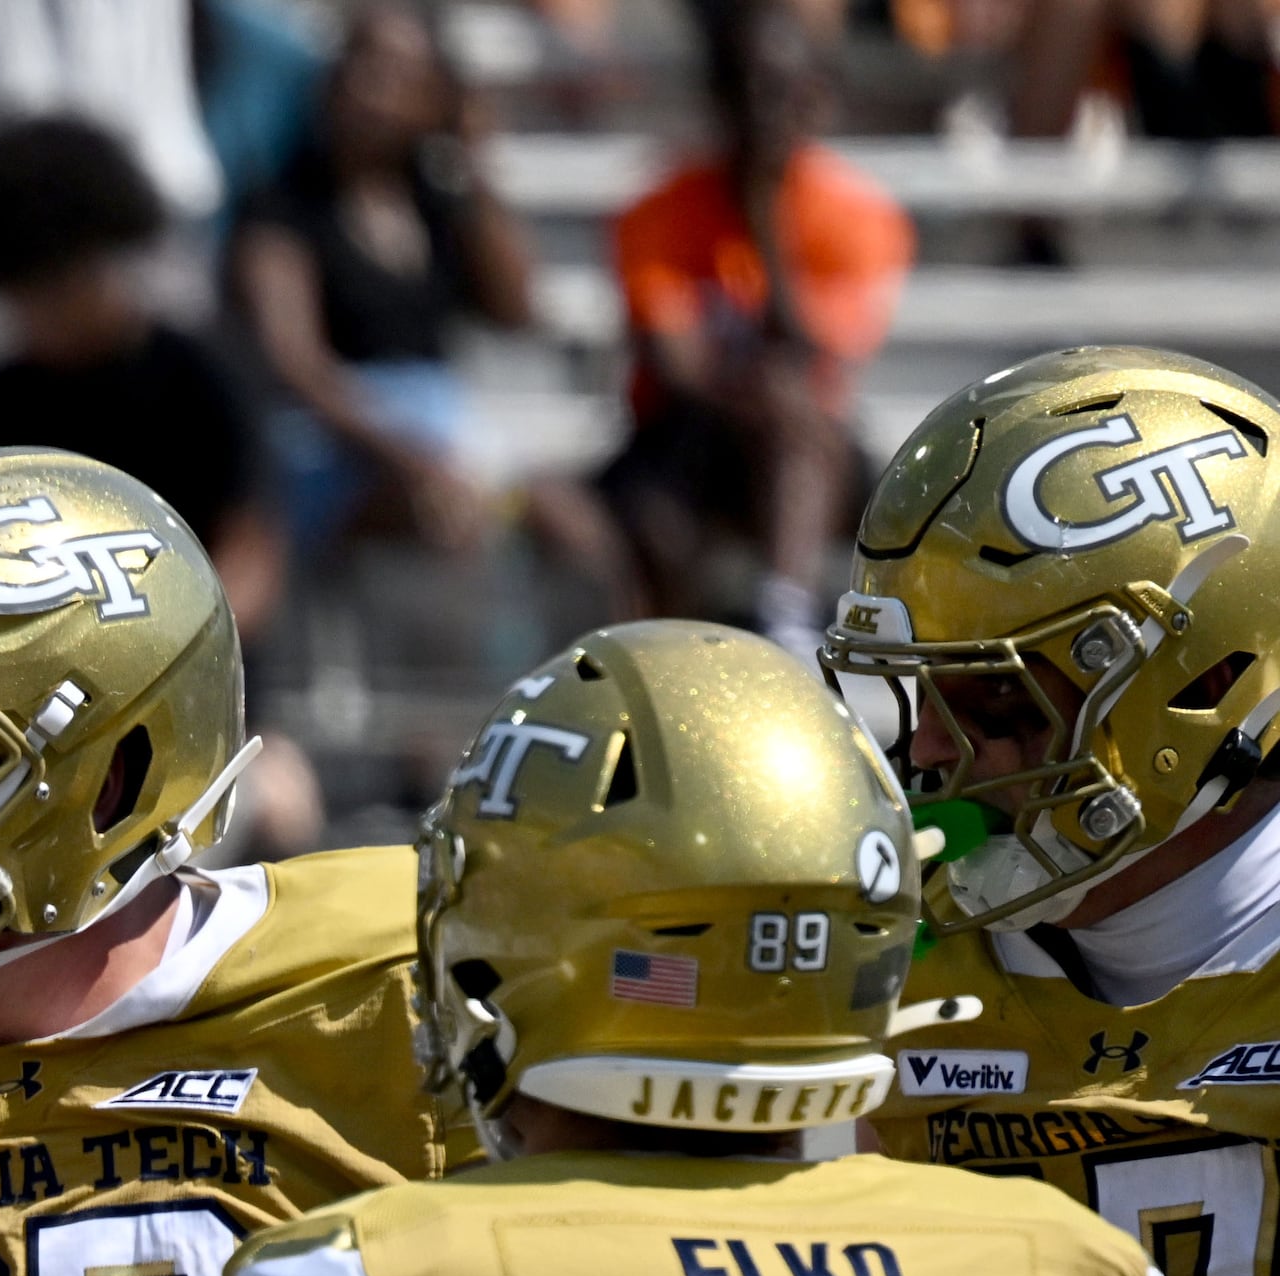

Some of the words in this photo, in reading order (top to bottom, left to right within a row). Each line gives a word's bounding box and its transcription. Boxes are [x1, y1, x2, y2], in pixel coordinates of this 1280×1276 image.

[1000, 413, 1248, 554] GT
[749, 911, 831, 973] 89
[126, 1072, 257, 1103] ACC
[631, 1075, 876, 1123] JACKETS
[83, 1125, 271, 1189] TECH
[927, 1110, 1136, 1165] GEORGIA
